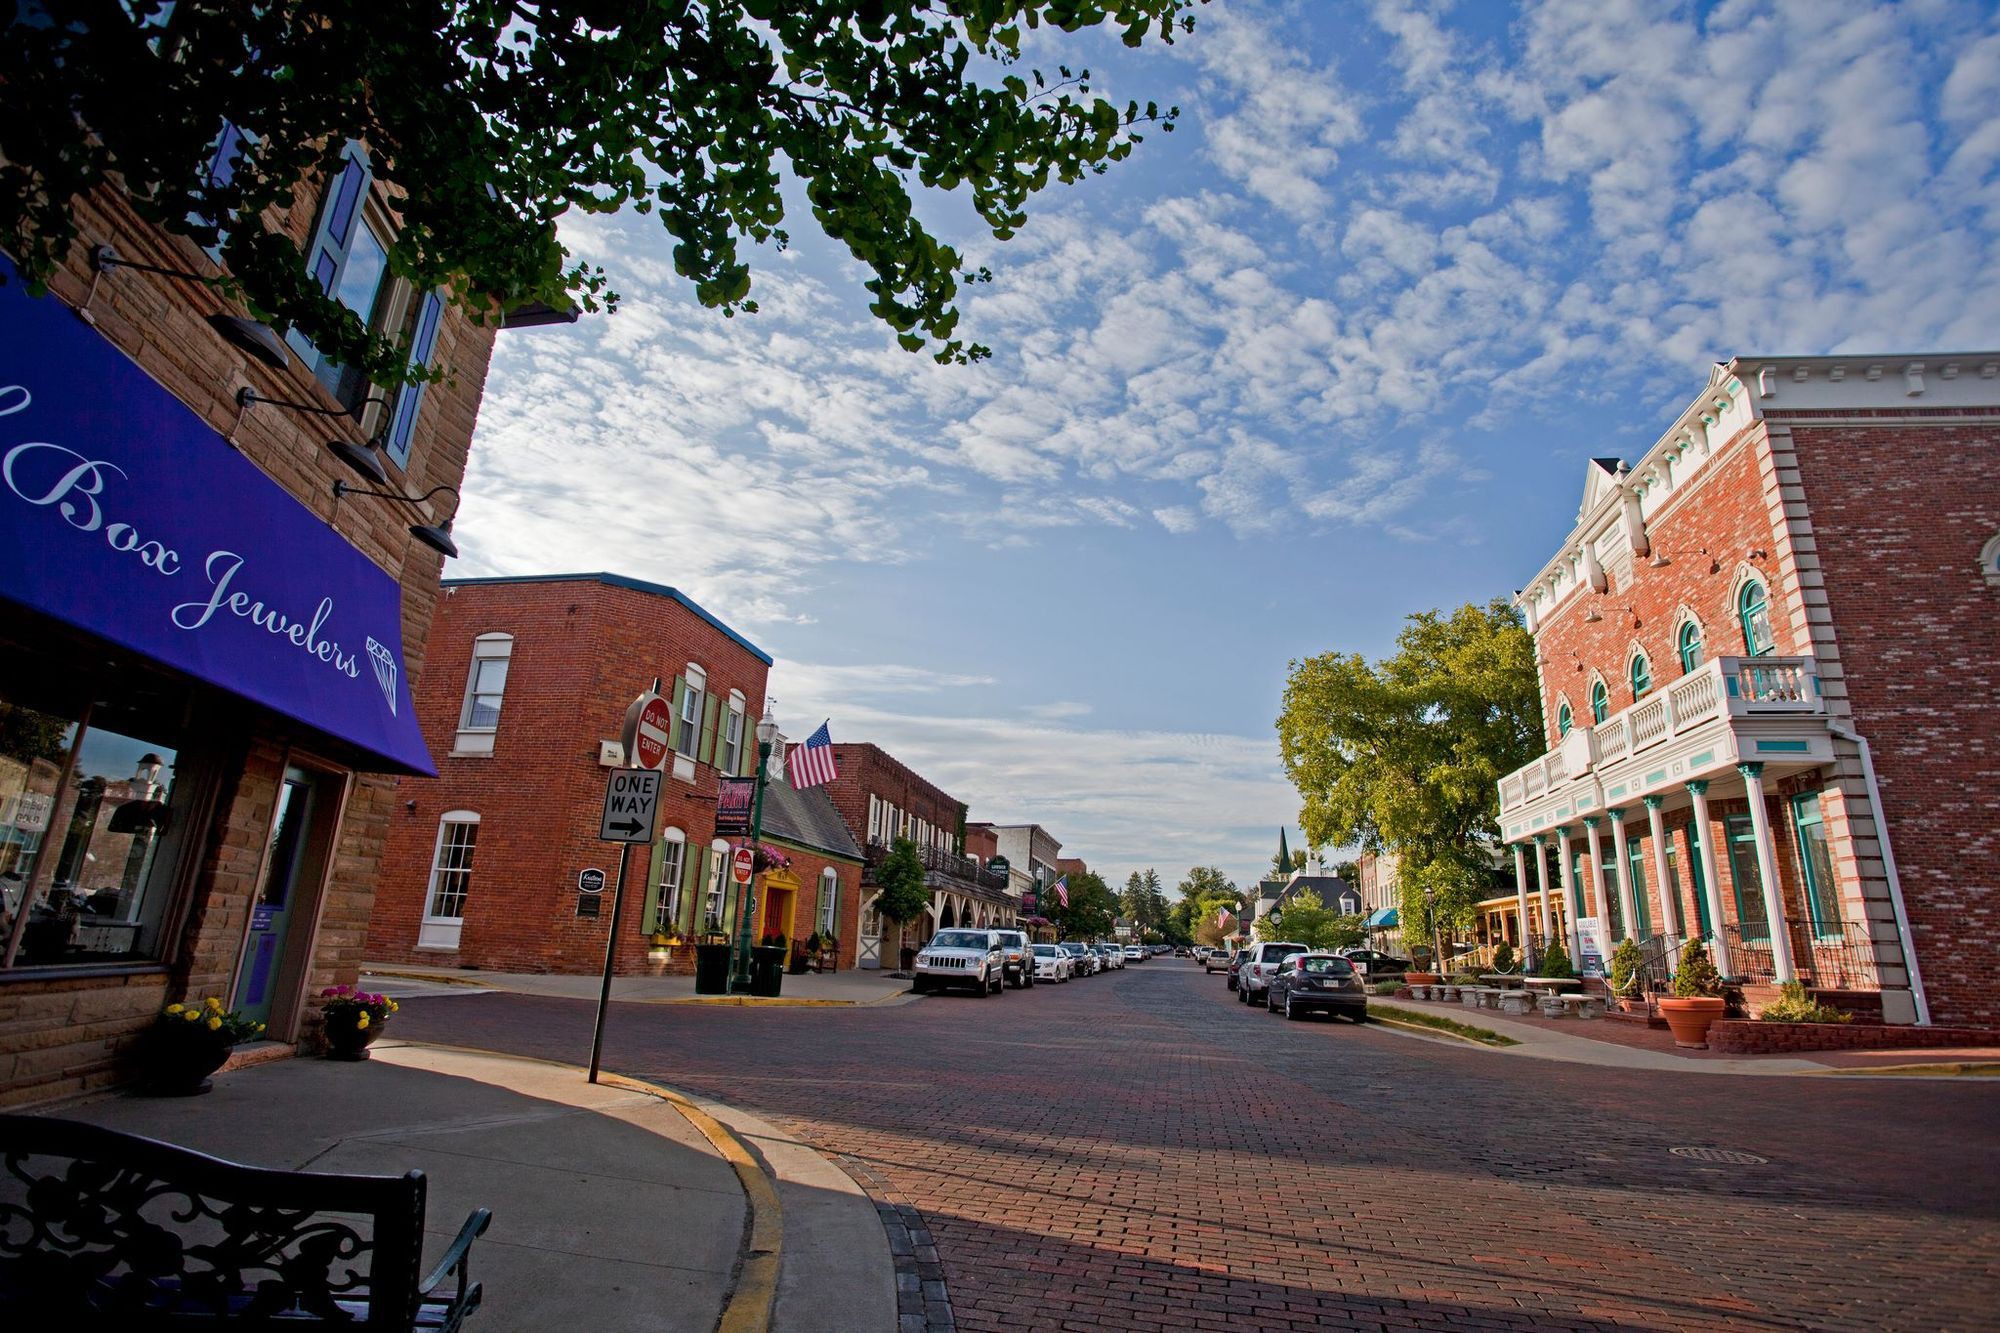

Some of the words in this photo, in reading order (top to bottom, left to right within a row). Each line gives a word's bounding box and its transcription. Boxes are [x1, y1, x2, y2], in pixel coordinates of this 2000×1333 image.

[2, 442, 181, 576] Box
[171, 550, 361, 678] Jewelers
[645, 709, 655, 722] DO
[656, 715, 668, 729] NOT
[641, 738, 661, 755] ENTER
[615, 776, 654, 794] ONE
[611, 796, 652, 814] WAY
[16, 813, 39, 824] GOLD
